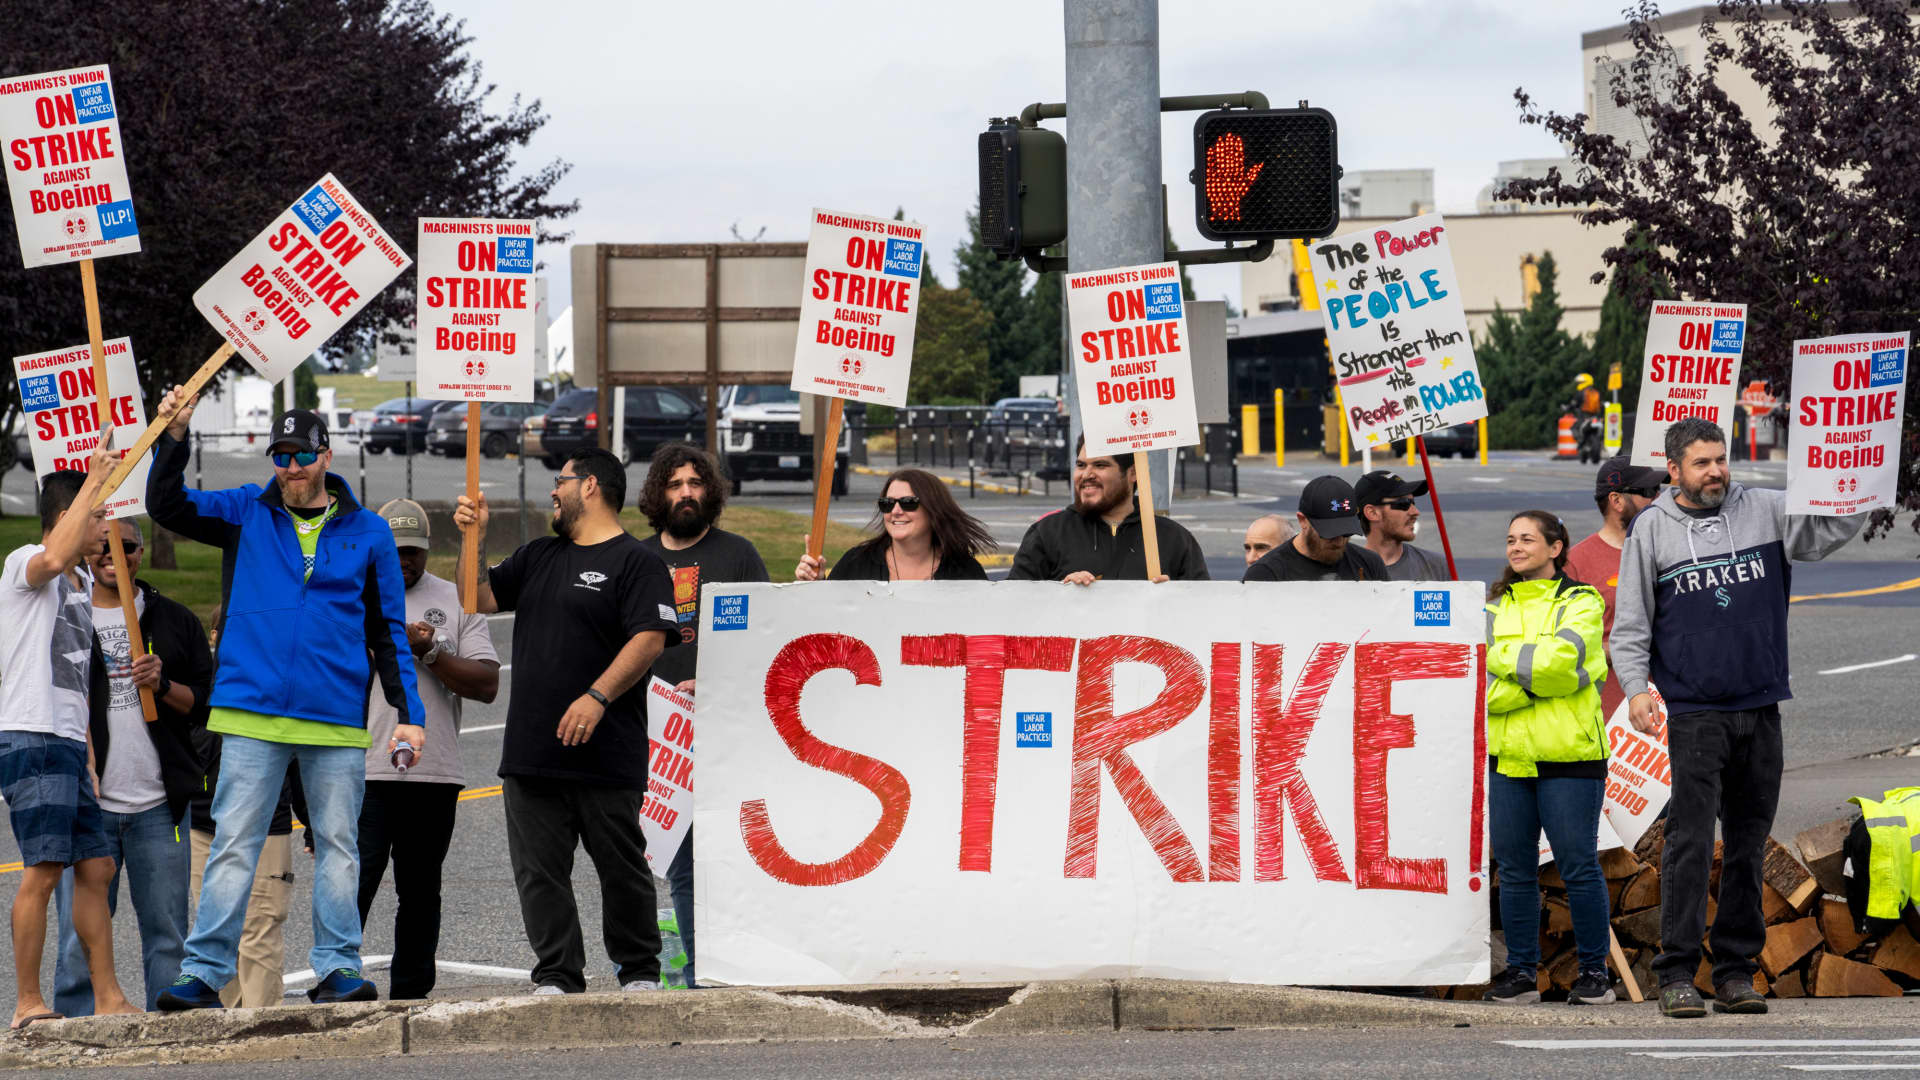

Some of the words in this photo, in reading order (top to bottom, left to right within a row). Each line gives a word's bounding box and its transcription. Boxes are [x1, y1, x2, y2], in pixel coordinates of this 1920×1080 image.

[0, 76, 67, 95] MACHINISTS
[69, 70, 104, 85] UNION
[80, 86, 102, 97] UNFAIR
[82, 95, 104, 106] LABOR
[35, 93, 77, 129] ON
[77, 103, 113, 118] PRACTICES!
[10, 127, 114, 171] STRIKE
[43, 167, 91, 186] AGAINST
[29, 183, 113, 214] Boeing
[316, 192, 340, 213] UNFAIR
[101, 208, 132, 227] ULP!
[298, 199, 326, 230] PRACTICES!
[308, 200, 330, 220] LABOR
[322, 180, 378, 239] MACHINISTS
[374, 235, 404, 268] UNION
[423, 222, 494, 236] MACHINISTS
[496, 223, 531, 235] UNION
[816, 213, 886, 234] MACHINISTS
[888, 224, 922, 240] UNION
[66, 242, 90, 252] DISTRICT
[319, 220, 366, 267] ON
[504, 239, 527, 249] UNFAIR
[505, 248, 526, 258] LABOR
[893, 241, 916, 252] UNFAIR
[1316, 242, 1370, 272] The
[1374, 226, 1444, 259] Power
[458, 240, 496, 272] ON
[498, 258, 532, 268] PRACTICES!
[846, 236, 886, 272] ON
[893, 251, 913, 262] LABOR
[268, 222, 360, 317] STRIKE
[885, 259, 920, 273] PRACTICES!
[272, 266, 314, 308] AGAINST
[1072, 271, 1139, 289] MACHINISTS
[1142, 266, 1175, 280] UNION
[1349, 269, 1368, 290] of
[1375, 266, 1404, 284] the
[426, 276, 527, 309] STRIKE
[812, 268, 911, 314] STRIKE
[1151, 285, 1174, 296] UNFAIR
[1153, 295, 1173, 305] LABOR
[1326, 268, 1448, 330] PEOPLE
[240, 264, 312, 340] Boeing
[1107, 288, 1146, 322] ON
[1146, 303, 1181, 314] PRACTICES!
[1656, 305, 1712, 316] MACHINISTS
[1714, 306, 1742, 318] UNION
[452, 312, 500, 326] AGAINST
[834, 308, 882, 326] AGAINST
[1720, 322, 1738, 331] UNFAIR
[230, 322, 249, 342] DISTRICT
[436, 326, 516, 355] Boeing
[816, 319, 896, 358] Boeing
[1678, 322, 1712, 350] ON
[1081, 322, 1181, 364] STRIKE
[1338, 339, 1423, 376] Stronger
[1424, 328, 1464, 351] than
[1712, 339, 1742, 348] PRACTICES!
[1799, 341, 1870, 356] MACHINISTS
[1872, 337, 1904, 351] UNION
[20, 350, 90, 372] MACHINISTS
[104, 342, 127, 356] ION
[1878, 351, 1898, 362] UNFAIR
[1878, 360, 1897, 370] LABOR
[1110, 360, 1157, 378] AGAINST
[1650, 354, 1734, 386] STRIKE
[1833, 358, 1871, 392] ON
[1872, 370, 1903, 382] PRACTICES!
[26, 377, 50, 388] UNFAIR
[58, 366, 96, 401] ON
[836, 380, 860, 390] DISTRICT
[860, 383, 876, 392] LODGE
[876, 386, 885, 394] 751
[1386, 370, 1416, 392] the
[29, 386, 50, 396] LABOR
[464, 390, 486, 398] AFL-CIO
[1096, 376, 1176, 406] Boeing
[1668, 388, 1708, 400] AGAINST
[24, 395, 58, 407] PRACTICES!
[1350, 398, 1404, 432] People
[1402, 394, 1418, 412] in
[1418, 370, 1483, 413] POWER
[1800, 390, 1897, 427] STRIKE
[34, 395, 137, 442] STRIKE
[1652, 400, 1720, 424] Boeing
[1128, 432, 1151, 442] DISTRICT
[1152, 431, 1168, 439] LODGE
[1385, 425, 1416, 443] IAM
[1412, 412, 1448, 434] 751
[1825, 429, 1872, 444] AGAINST
[67, 436, 100, 454] AGAIN
[1132, 440, 1153, 448] AFL-CIO
[1808, 444, 1884, 470] Boeing
[1833, 498, 1856, 507] DISTRICT
[389, 516, 418, 528] PFG
[720, 596, 742, 606] UNFAIR
[1421, 592, 1444, 602] UNFAIR
[676, 602, 696, 614] NTER
[720, 606, 742, 616] LABOR
[1415, 611, 1449, 621] PRACTICES!
[1422, 602, 1442, 612] LABOR
[714, 615, 747, 625] PRACTICES!
[652, 683, 694, 713] MACHINIS
[1023, 714, 1046, 723] UNFAIR
[1024, 723, 1044, 733] LABOR
[663, 712, 694, 751] ON
[1017, 733, 1052, 742] PRACTICES!
[648, 738, 694, 792] TRIK
[739, 632, 1487, 894] STRIKE!
[1608, 762, 1648, 789] AGAINST
[648, 777, 676, 800] AINST
[1605, 777, 1648, 816] eing
[640, 795, 678, 831] eing
